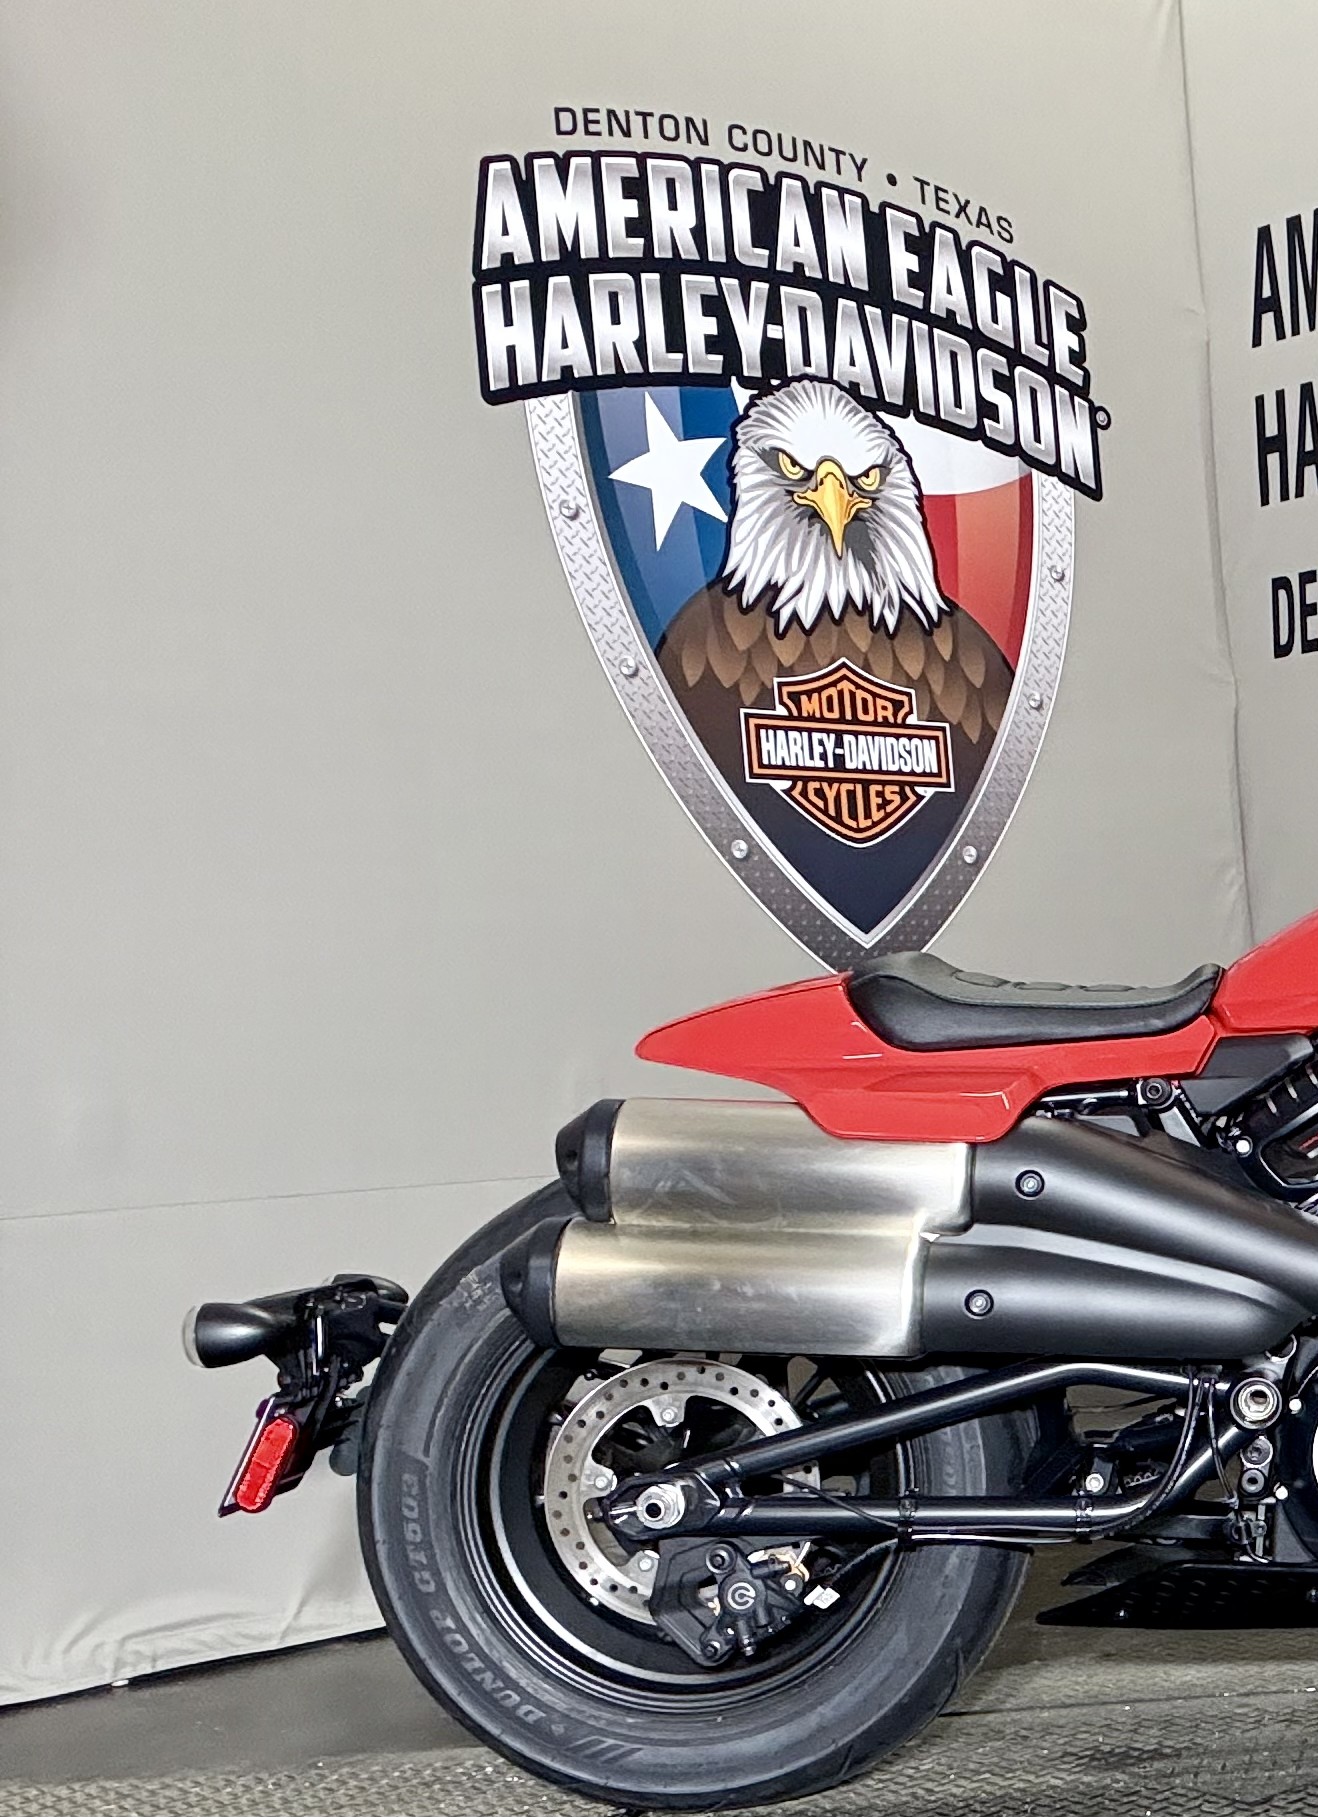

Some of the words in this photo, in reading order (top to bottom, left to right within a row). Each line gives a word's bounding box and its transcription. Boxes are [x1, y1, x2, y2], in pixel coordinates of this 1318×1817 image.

[553, 106, 710, 147] DENTON
[727, 124, 868, 184] COUNTY
[912, 176, 1014, 244] TEXAS
[480, 155, 870, 291] AMERICAN
[885, 205, 1085, 387] EAGLE
[799, 680, 895, 725] MOTOR
[759, 728, 939, 774] HARLEY-DAVIDSON
[807, 780, 901, 829] CYCLES
[429, 1607, 547, 1725] DUNLOP
